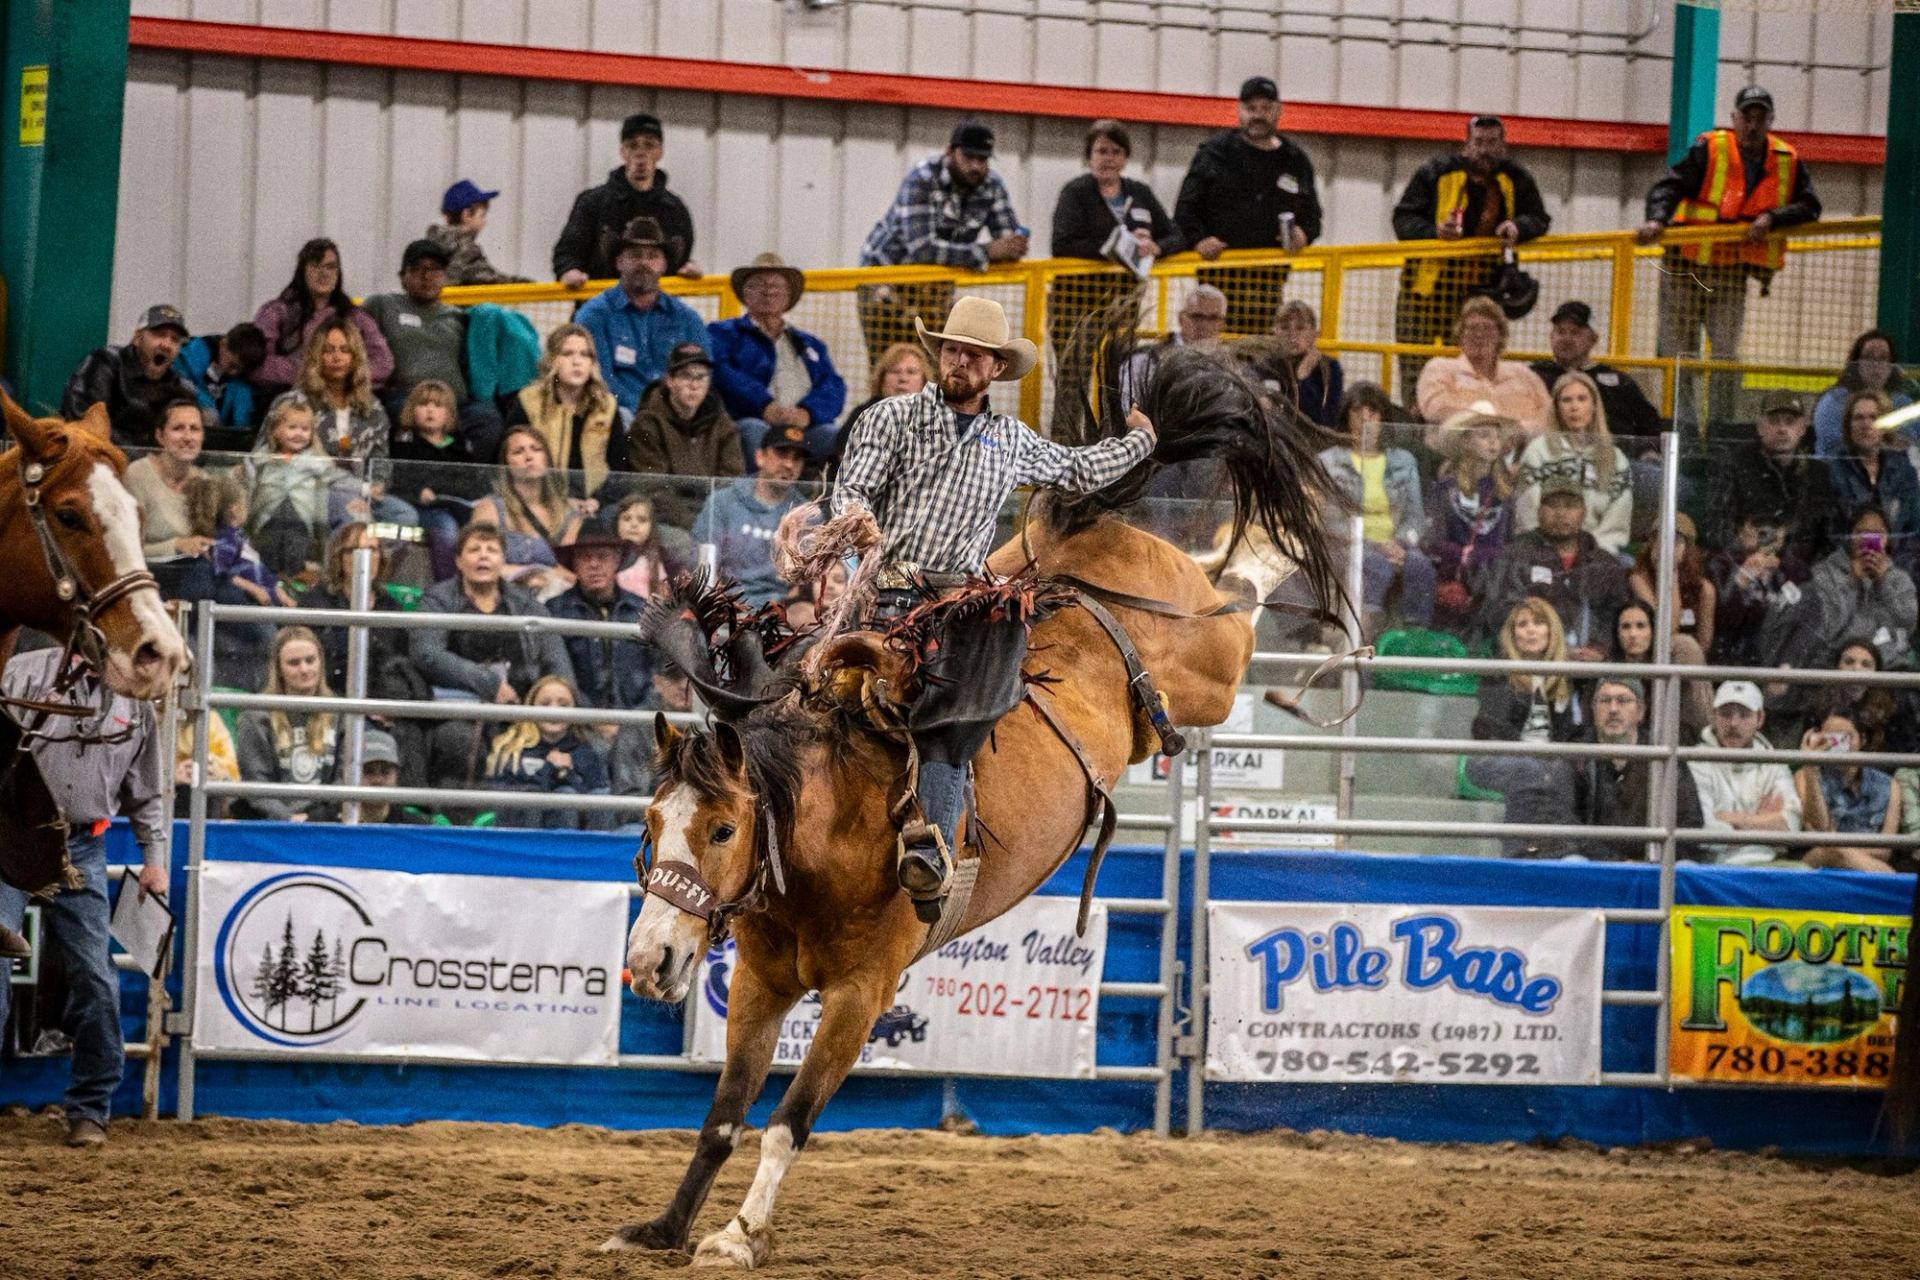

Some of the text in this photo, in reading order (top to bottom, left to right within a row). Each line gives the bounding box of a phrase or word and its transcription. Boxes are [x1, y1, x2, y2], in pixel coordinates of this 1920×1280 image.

[1187, 751, 1262, 768] DRKAI
[649, 867, 711, 908] DUFFY
[349, 937, 608, 997] Crossterra
[938, 929, 1096, 976] ayton Valley
[1246, 914, 1561, 1013] Pile Base
[1681, 916, 1908, 1031] FOOTH
[377, 996, 599, 1015] LINE LOCATING
[927, 977, 1092, 1022] 780 202-2712
[1247, 1022, 1564, 1043] CONTRACTORS (1987) LTD.
[1255, 1049, 1541, 1076] 780-542-5292
[1706, 1044, 1890, 1078] 780-388
